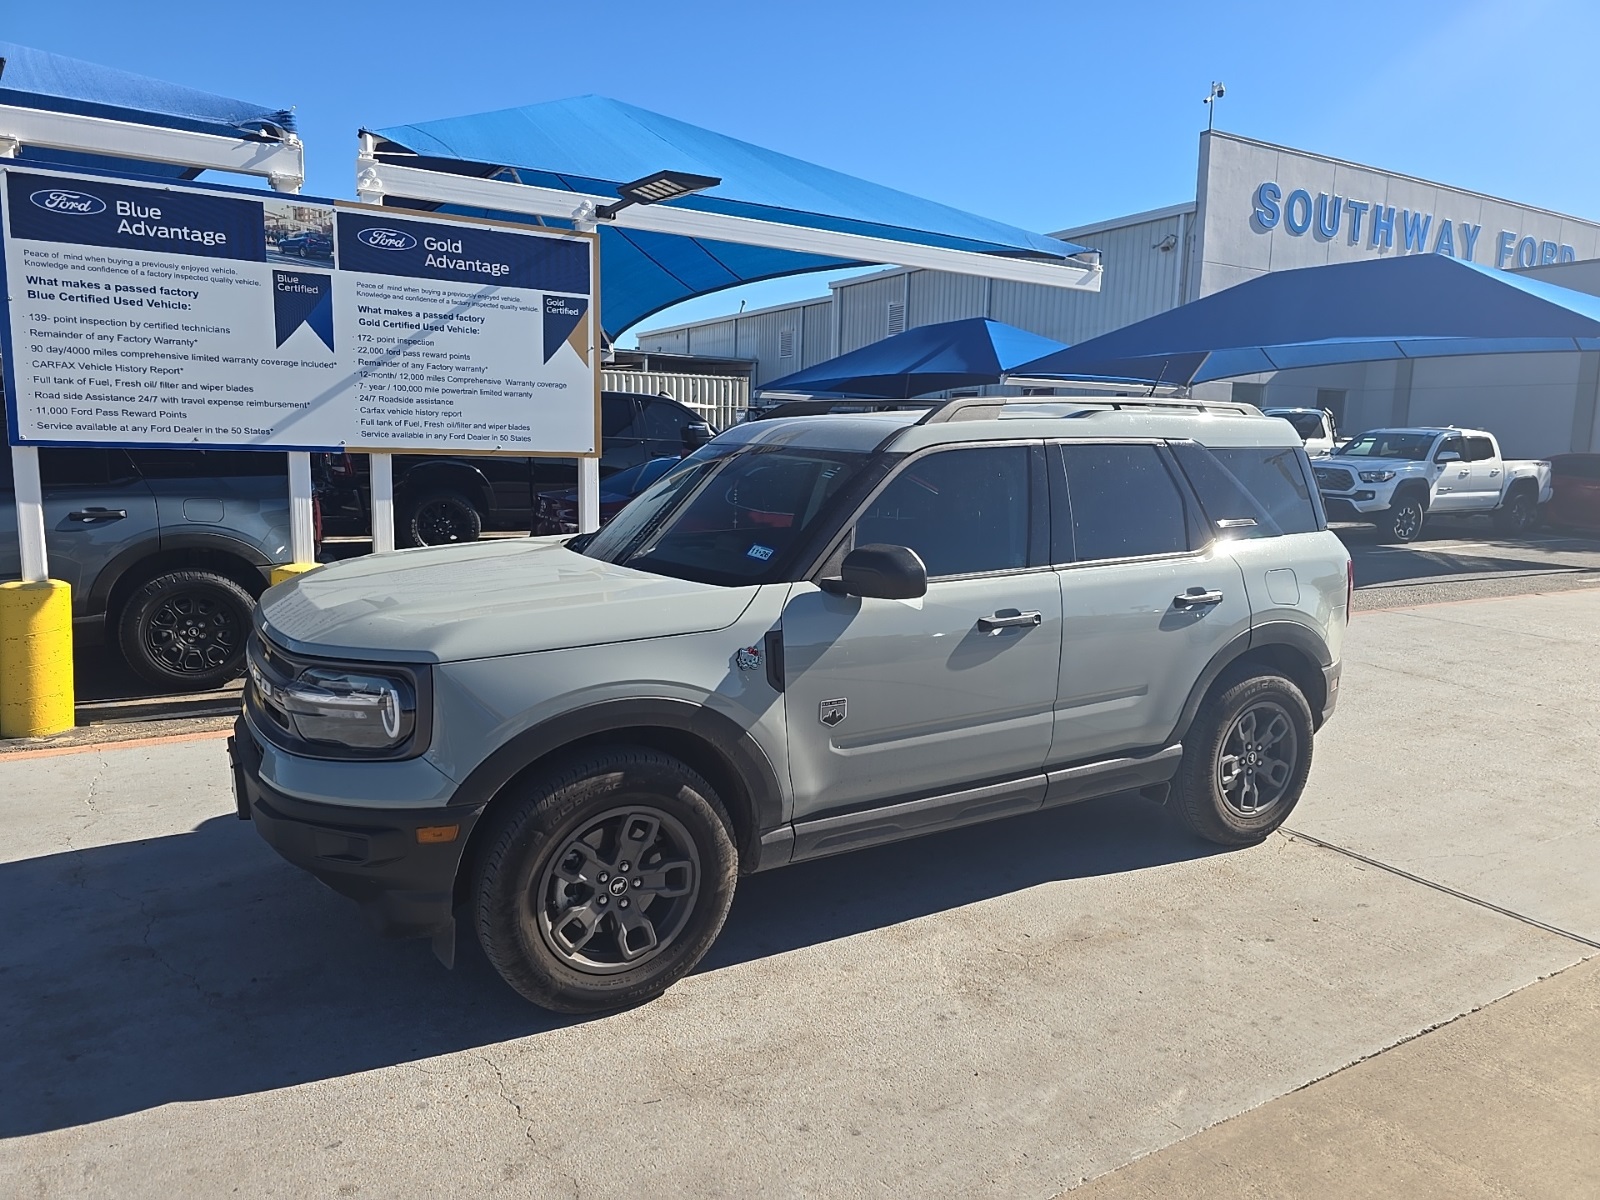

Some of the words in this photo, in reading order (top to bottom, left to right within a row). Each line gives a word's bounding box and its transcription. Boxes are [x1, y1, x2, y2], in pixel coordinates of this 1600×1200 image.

[45, 190, 92, 214] Ford
[116, 201, 162, 220] Blue
[1256, 181, 1482, 261] SOUTHWAY
[117, 220, 227, 245] Advantage
[369, 229, 406, 248] Ford
[424, 237, 462, 254] Gold
[23, 248, 49, 258] Peace
[51, 251, 59, 259] of
[63, 253, 83, 261] mind
[84, 255, 106, 263] when
[106, 256, 133, 267] buying
[141, 261, 180, 271] previously
[180, 264, 210, 273] enjoyed
[424, 254, 510, 276] Advantage
[25, 275, 59, 287] What
[61, 279, 101, 290] makes
[104, 283, 111, 291] a
[114, 284, 157, 294] passed
[159, 286, 199, 300] factory
[278, 274, 299, 284] Blue
[277, 283, 319, 294] Certified
[26, 289, 55, 300] Blue
[58, 291, 110, 305] Certified
[113, 296, 143, 307] Used
[145, 298, 191, 311] Vehicle:
[546, 298, 565, 307] Gold
[357, 304, 382, 315] What
[383, 308, 413, 317] makes
[422, 311, 454, 321] passed
[455, 312, 485, 325] factory
[546, 306, 579, 316] Certified
[28, 313, 51, 322] 139-
[53, 315, 78, 324] point
[79, 316, 128, 328] inspection
[129, 319, 141, 330] by
[142, 321, 179, 331] certified
[181, 323, 231, 334] technicians
[358, 317, 381, 327] Gold
[382, 320, 421, 330] Certified
[422, 323, 445, 332] Used
[446, 324, 480, 335] Vehicle:
[29, 328, 83, 339] Remainder
[85, 331, 95, 340] of
[96, 334, 115, 343] any
[116, 333, 152, 346] Factory
[356, 333, 375, 343] 172-
[376, 335, 396, 344] point
[396, 337, 435, 347] inspection
[30, 344, 44, 353] 90
[45, 345, 91, 356] day/4000
[92, 347, 118, 357] miles
[120, 350, 189, 361] comprehensive
[191, 353, 220, 363] limited
[221, 356, 259, 367] warranty
[260, 358, 299, 368] coverage
[357, 345, 384, 356] 22,000
[385, 347, 401, 356] ford
[402, 350, 421, 359] pass
[421, 351, 448, 359] reward
[448, 353, 471, 361] points
[31, 359, 76, 370] CARFAX
[77, 361, 113, 372] Vehicle
[114, 363, 148, 375] History
[357, 358, 400, 368] Remainder
[410, 362, 425, 371] any
[426, 362, 454, 373] Factory
[32, 375, 51, 384] Full
[53, 376, 74, 385] tank
[76, 376, 87, 386] of
[114, 378, 142, 388] Fresh
[181, 382, 198, 390] and
[199, 382, 224, 392] wiper
[225, 383, 254, 393] blades
[399, 372, 425, 382] 12,000
[426, 374, 446, 383] miles
[446, 375, 502, 385] Comprehensive
[504, 378, 536, 389] Warranty
[536, 381, 567, 390] coverage
[34, 390, 61, 400] Road
[62, 391, 83, 400] side
[84, 392, 136, 403] Assistance
[137, 394, 158, 403] 24/7
[160, 396, 179, 404] with
[180, 396, 206, 405] travel
[206, 399, 244, 407] expense
[368, 384, 386, 392] year
[392, 383, 423, 393] 100,000
[424, 386, 440, 394] mile
[441, 387, 478, 395] powertrain
[479, 388, 503, 397] limited
[503, 391, 533, 399] warranty
[359, 394, 377, 403] 24/7
[378, 395, 414, 404] Roadside
[415, 397, 454, 406] assistance
[35, 406, 68, 416] 11,000
[70, 407, 93, 416] Ford
[95, 407, 119, 417] Pass
[121, 408, 157, 418] Reward
[158, 410, 187, 419] Points
[359, 406, 386, 414] Carfax
[386, 407, 413, 416] vehicle
[414, 408, 440, 418] history
[440, 410, 462, 418] report
[36, 421, 73, 430] Service
[75, 422, 117, 432] available
[119, 424, 129, 432] at
[131, 425, 148, 434] any
[150, 424, 172, 433] Ford
[173, 425, 203, 433] Dealer
[204, 426, 213, 434] in
[214, 426, 229, 434] the
[230, 426, 242, 435] 50
[360, 417, 375, 426] Full
[376, 419, 393, 427] tank
[394, 419, 403, 427] of
[423, 420, 445, 428] Fresh
[472, 422, 487, 430] and
[487, 422, 507, 431] wiper
[507, 423, 531, 431] blades
[360, 430, 390, 438] Service
[391, 431, 424, 439] available
[425, 431, 433, 439] in
[433, 433, 448, 441] any
[448, 432, 466, 440] Ford
[466, 433, 490, 441] Dealer
[491, 433, 498, 441] in
[499, 434, 509, 442] 50
[509, 434, 532, 442] States
